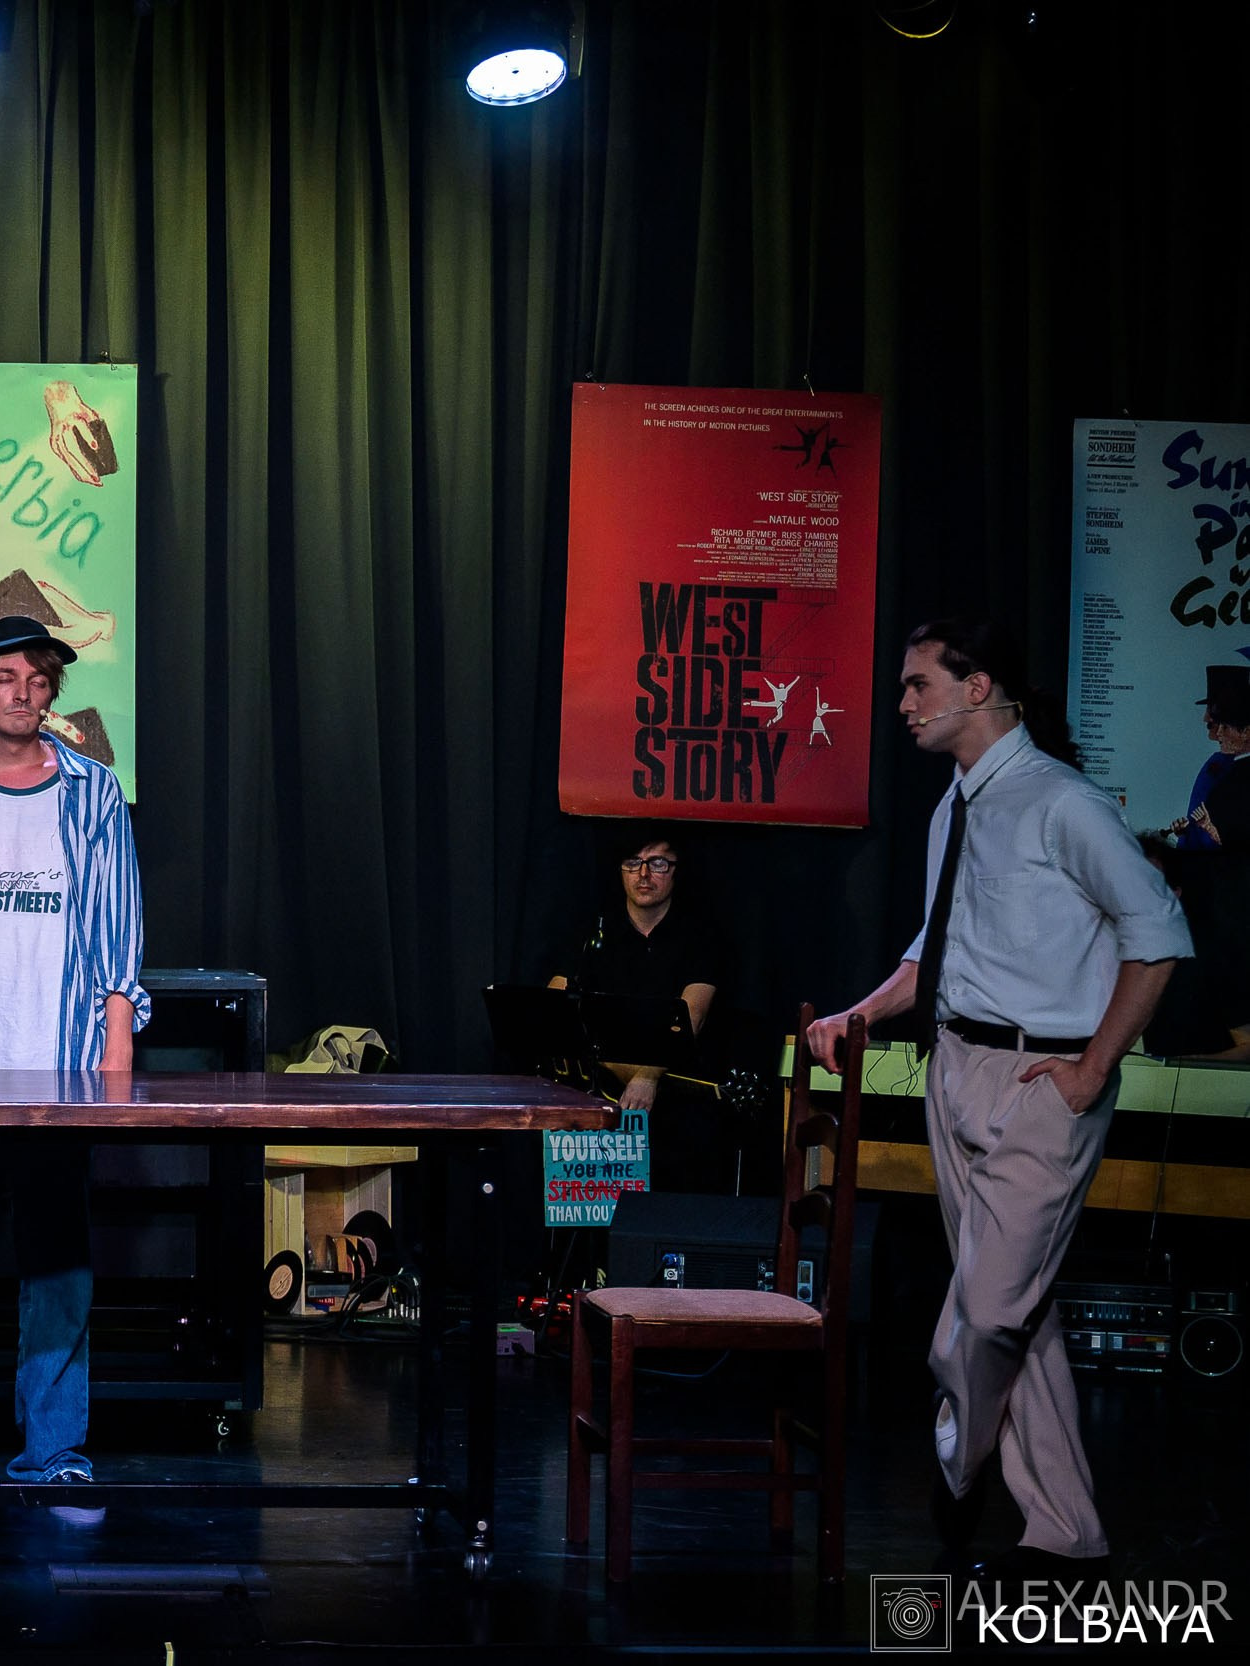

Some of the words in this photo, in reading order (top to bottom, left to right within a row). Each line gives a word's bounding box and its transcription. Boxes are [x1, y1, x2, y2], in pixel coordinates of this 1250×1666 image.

[644, 403, 657, 411] THE
[659, 403, 685, 412] SCREEN
[687, 404, 719, 414] ACHIEVES
[721, 406, 736, 414] ONE
[747, 407, 761, 415] THE
[762, 408, 783, 416] GREAT
[784, 409, 843, 419] ENTERTAINMENTS
[668, 420, 697, 429] HISTORY
[698, 421, 707, 429] OF
[709, 422, 736, 430] MOTION
[738, 423, 770, 432] PICTURES
[1088, 442, 1136, 453] SONDHEIM
[787, 493, 808, 502] SIDE
[769, 515, 806, 525] NATALIE
[811, 517, 839, 526] WOOD
[1086, 511, 1118, 519] STEPHEN
[1086, 520, 1123, 528] SONDHEIM
[711, 528, 744, 537] RICHARD
[747, 529, 777, 538] BEYMER
[782, 531, 802, 539] RUSS
[804, 532, 838, 540] TAMBLYN
[714, 536, 730, 544] RITA
[734, 537, 766, 545] MORENO
[771, 538, 800, 547] GEORGE
[804, 539, 838, 548] CHAKIRIS
[639, 582, 778, 657] WEST
[636, 653, 762, 729] SIDE
[632, 726, 788, 804] STORY
[13, 890, 62, 914] MEETS
[549, 1135, 647, 1161] YOURSELF
[562, 1163, 597, 1178] YOU
[601, 1163, 635, 1178] ARE
[548, 1205, 582, 1222] THAN
[585, 1205, 608, 1222] YOU
